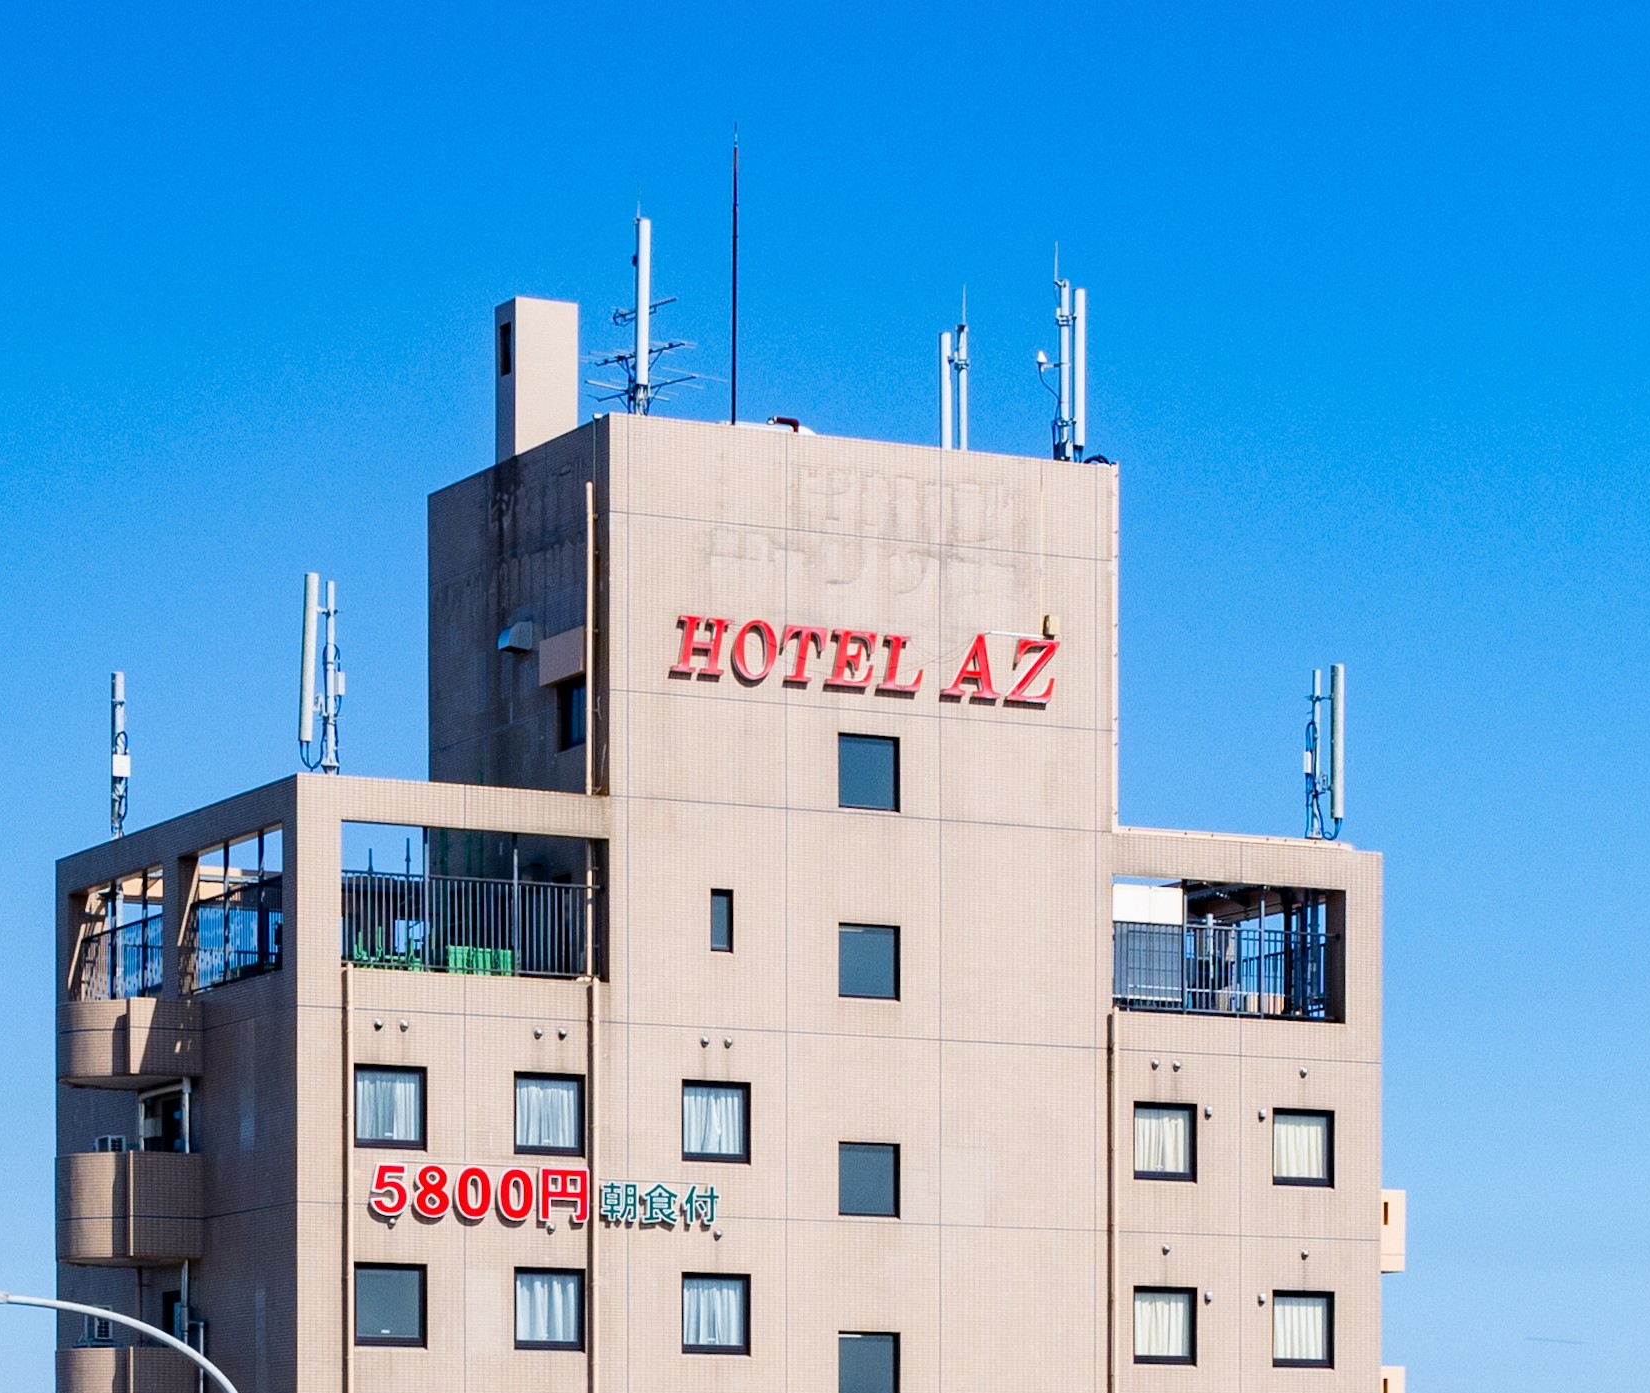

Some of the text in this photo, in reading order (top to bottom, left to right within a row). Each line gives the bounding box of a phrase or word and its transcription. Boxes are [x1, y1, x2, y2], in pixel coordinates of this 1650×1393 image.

[669, 614, 1061, 707] HOTEL AZ
[369, 1163, 720, 1225] 5800円 朝食付
